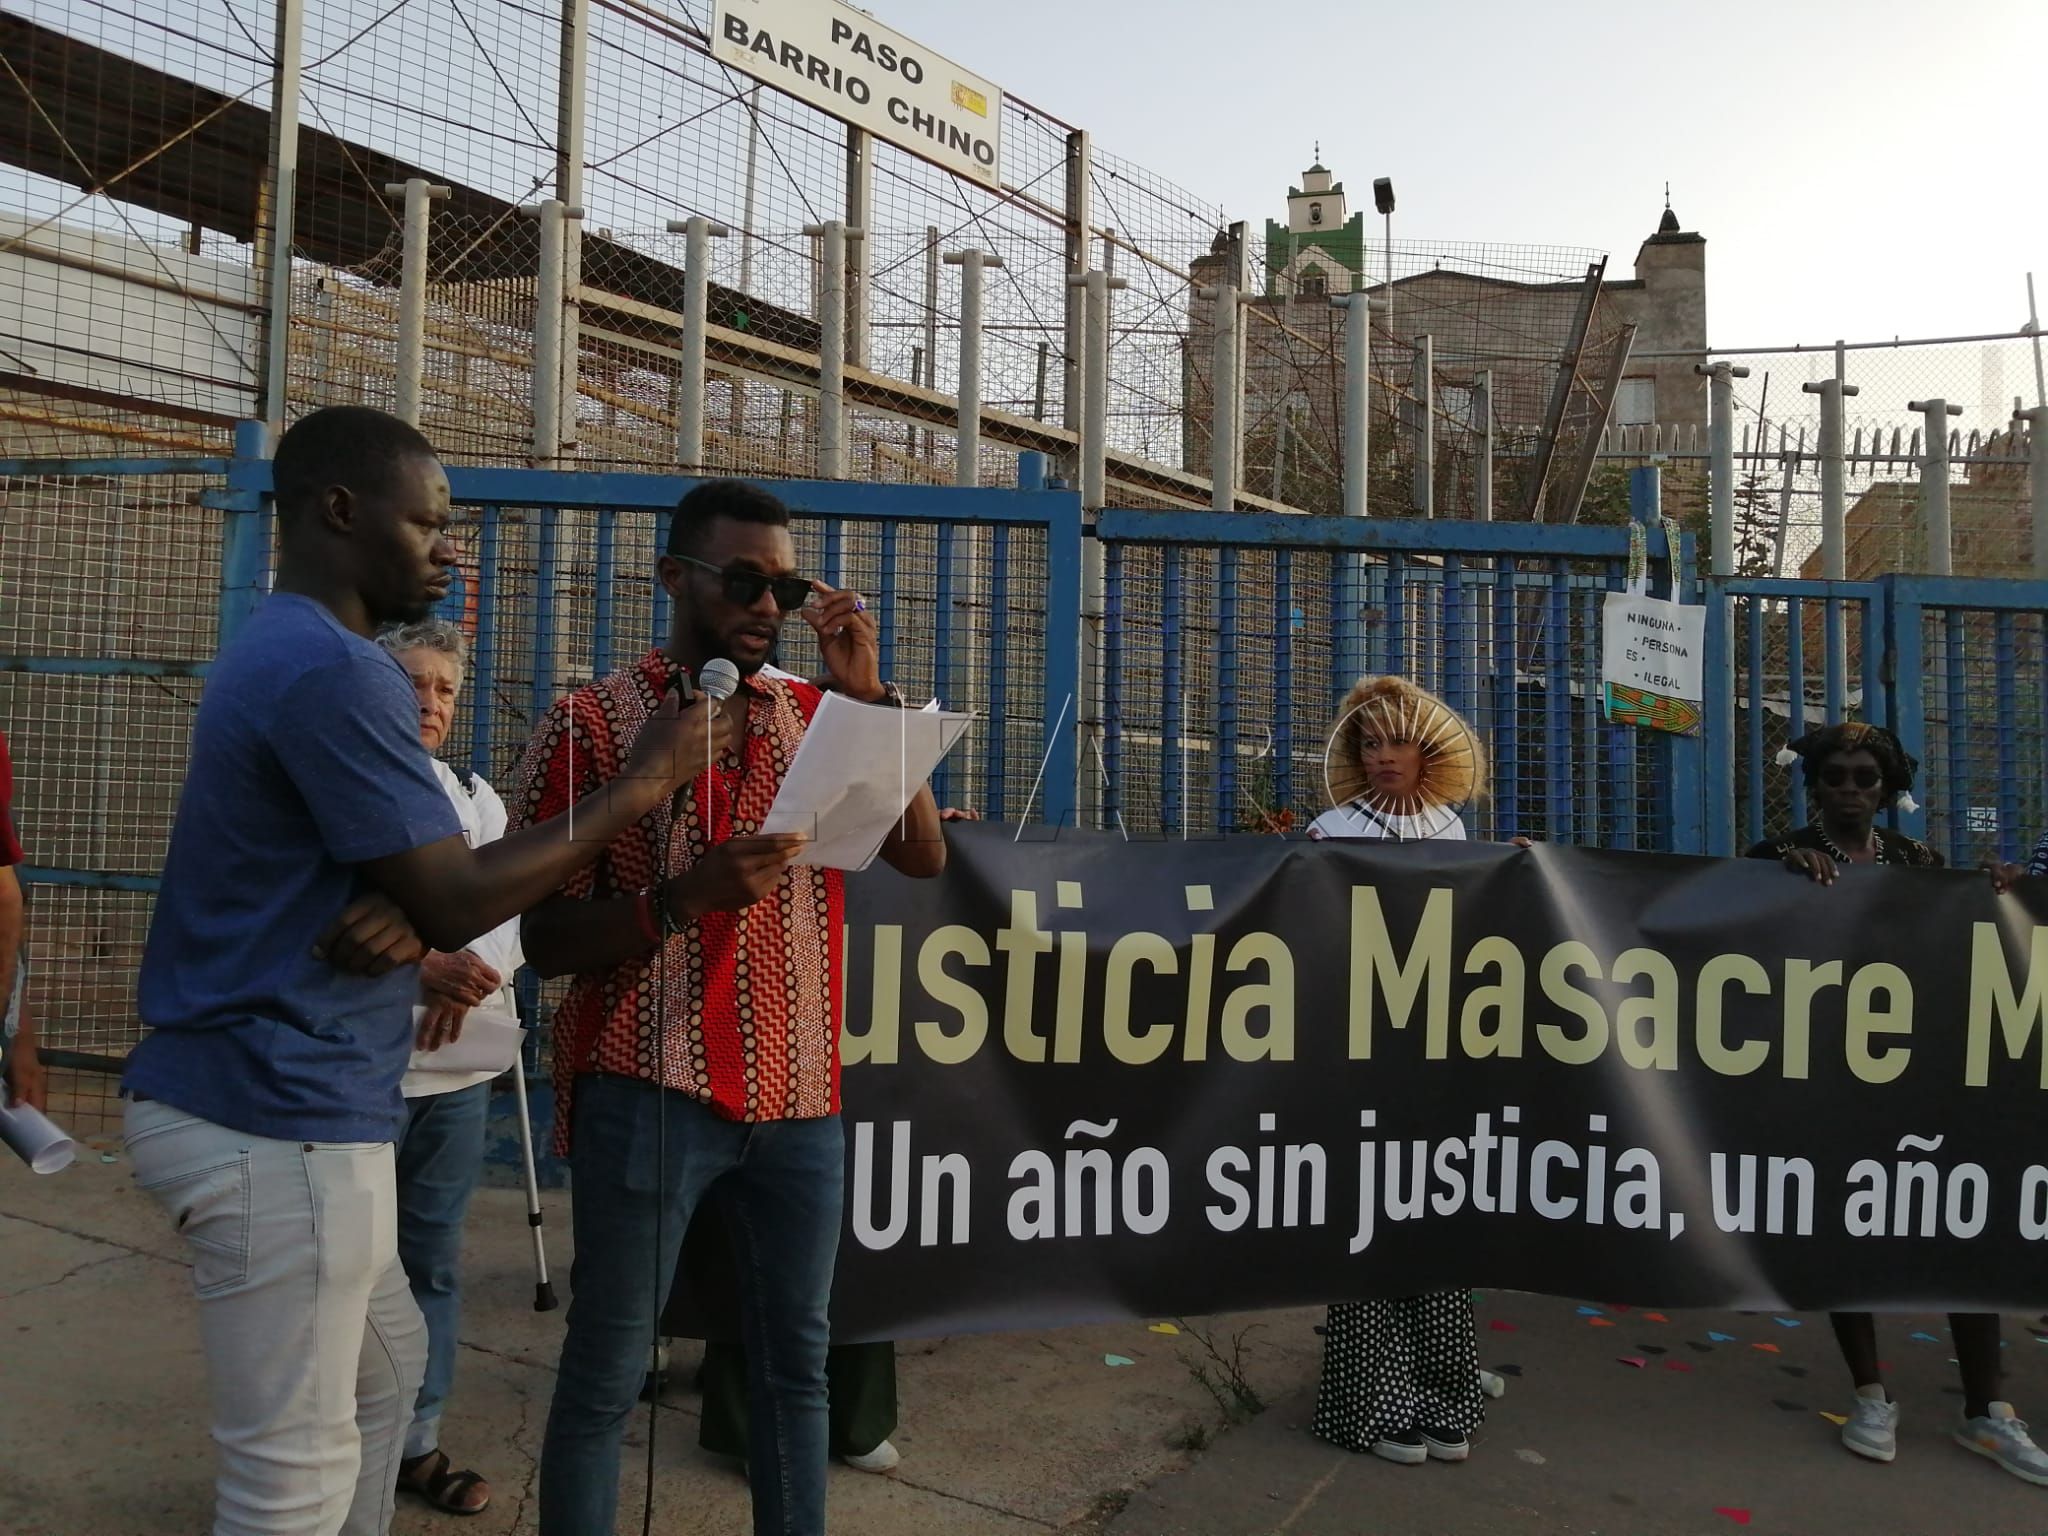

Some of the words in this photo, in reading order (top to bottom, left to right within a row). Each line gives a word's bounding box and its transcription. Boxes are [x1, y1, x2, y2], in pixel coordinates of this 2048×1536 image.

[831, 18, 923, 85] PASO
[724, 12, 870, 105] BARRIO
[887, 97, 994, 165] CHINO
[1627, 612, 1675, 633] NINGUNA
[1626, 648, 1638, 662] ES
[1641, 636, 1688, 658] PERSONA
[1643, 671, 1681, 690] ILEGAL
[838, 881, 1295, 1065] usticia
[1349, 884, 1914, 1084] Masacre
[1965, 921, 2048, 1090] M
[852, 1120, 972, 1251] Un
[1006, 1118, 1170, 1241] año
[1205, 1112, 1327, 1232] sin
[1349, 1105, 1685, 1255] justicia,
[1710, 1152, 1816, 1237] un
[1844, 1134, 1989, 1240] año
